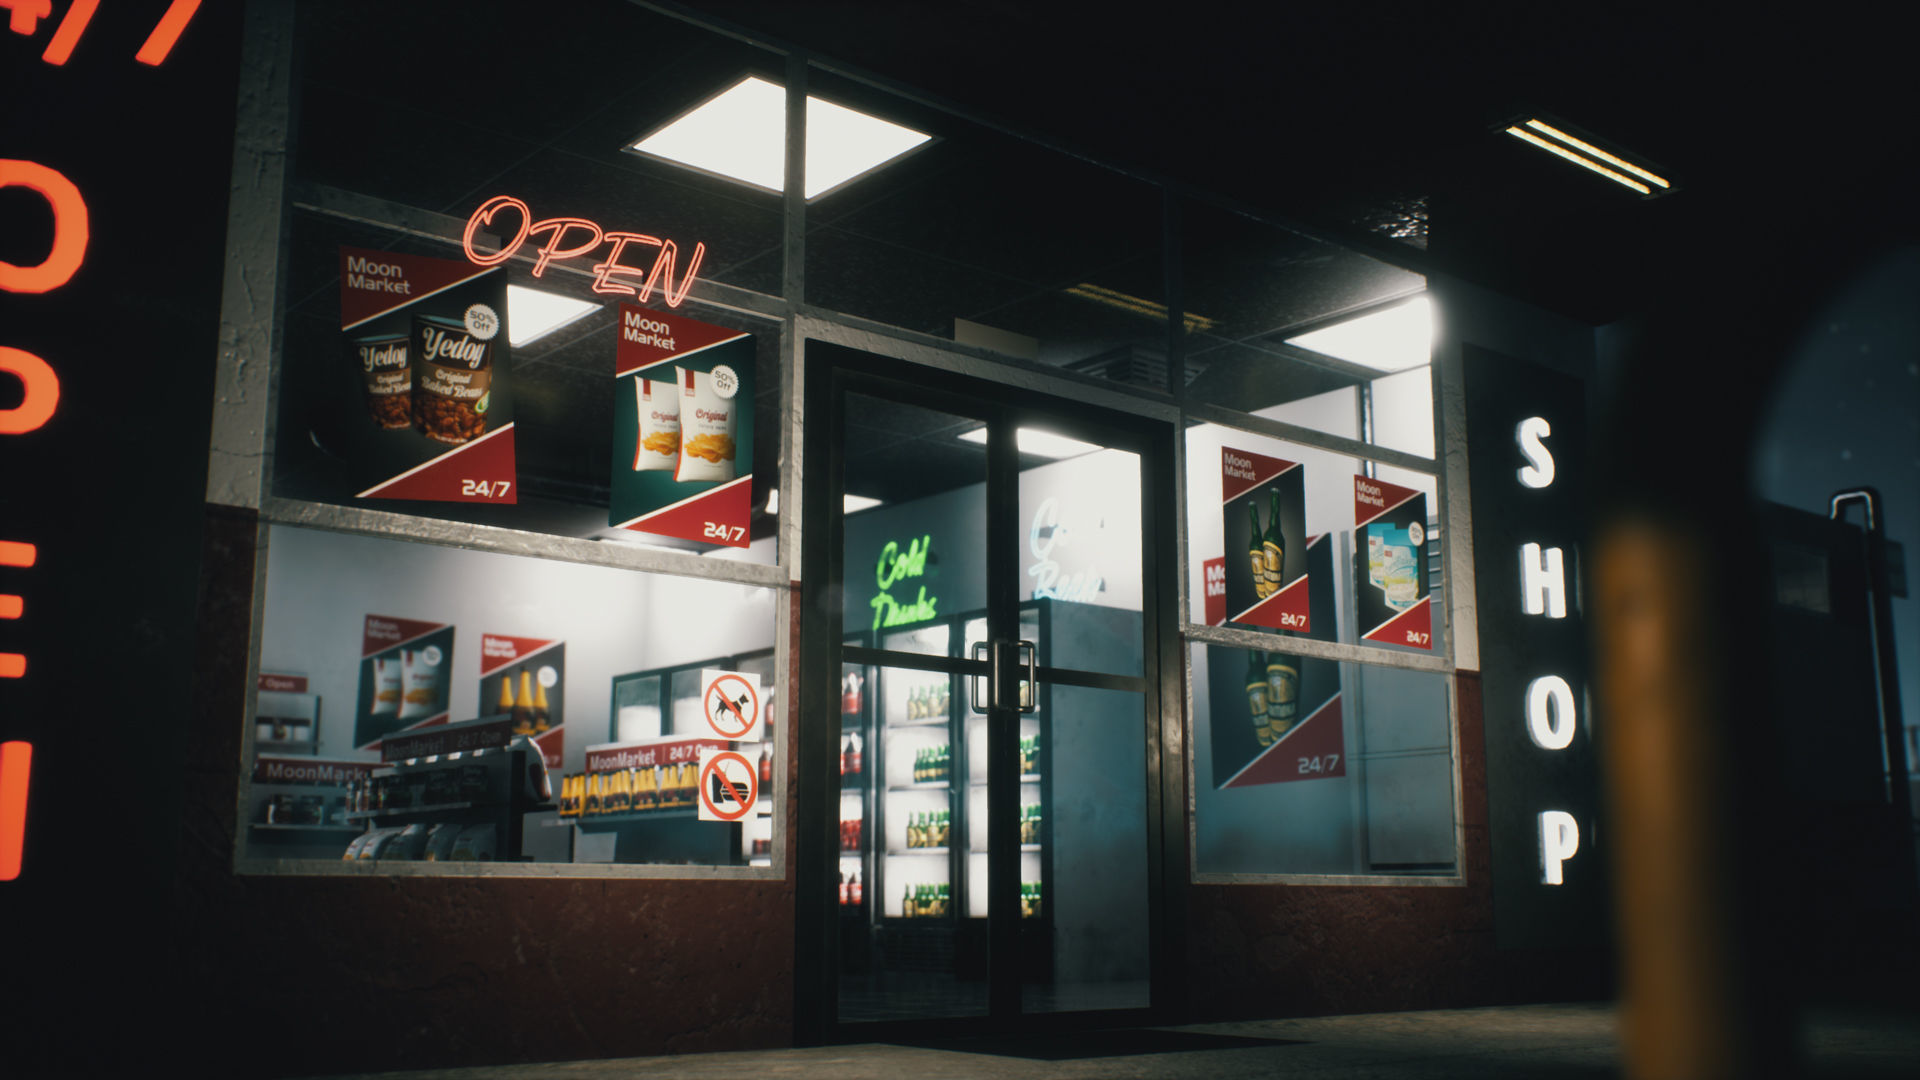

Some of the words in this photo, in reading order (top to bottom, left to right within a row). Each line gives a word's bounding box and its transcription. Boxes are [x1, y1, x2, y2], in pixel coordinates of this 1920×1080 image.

[463, 195, 705, 308] OPEN
[348, 255, 402, 278] Moon
[348, 273, 411, 295] Market
[469, 310, 495, 325] 50%
[625, 311, 669, 335] Moon
[473, 320, 491, 333] Off
[624, 326, 675, 351] Market
[423, 327, 486, 368] Yedoy
[714, 369, 736, 385] 50%
[716, 380, 731, 391] Off
[696, 408, 728, 423] Original
[1224, 453, 1252, 469] Moon
[1224, 466, 1256, 481] Market
[461, 479, 511, 497] 24/7
[1357, 480, 1381, 496] Moon
[1357, 491, 1385, 508] Market
[704, 521, 745, 541] 24/7
[877, 534, 930, 590] Cold
[1280, 612, 1307, 628] 24/7
[1406, 630, 1429, 645] 24/7
[1516, 416, 1579, 886] SHOP
[265, 678, 295, 689] Open
[590, 748, 655, 770] MoonMarket
[669, 745, 693, 760] 24/7
[1298, 754, 1339, 774] 24/7
